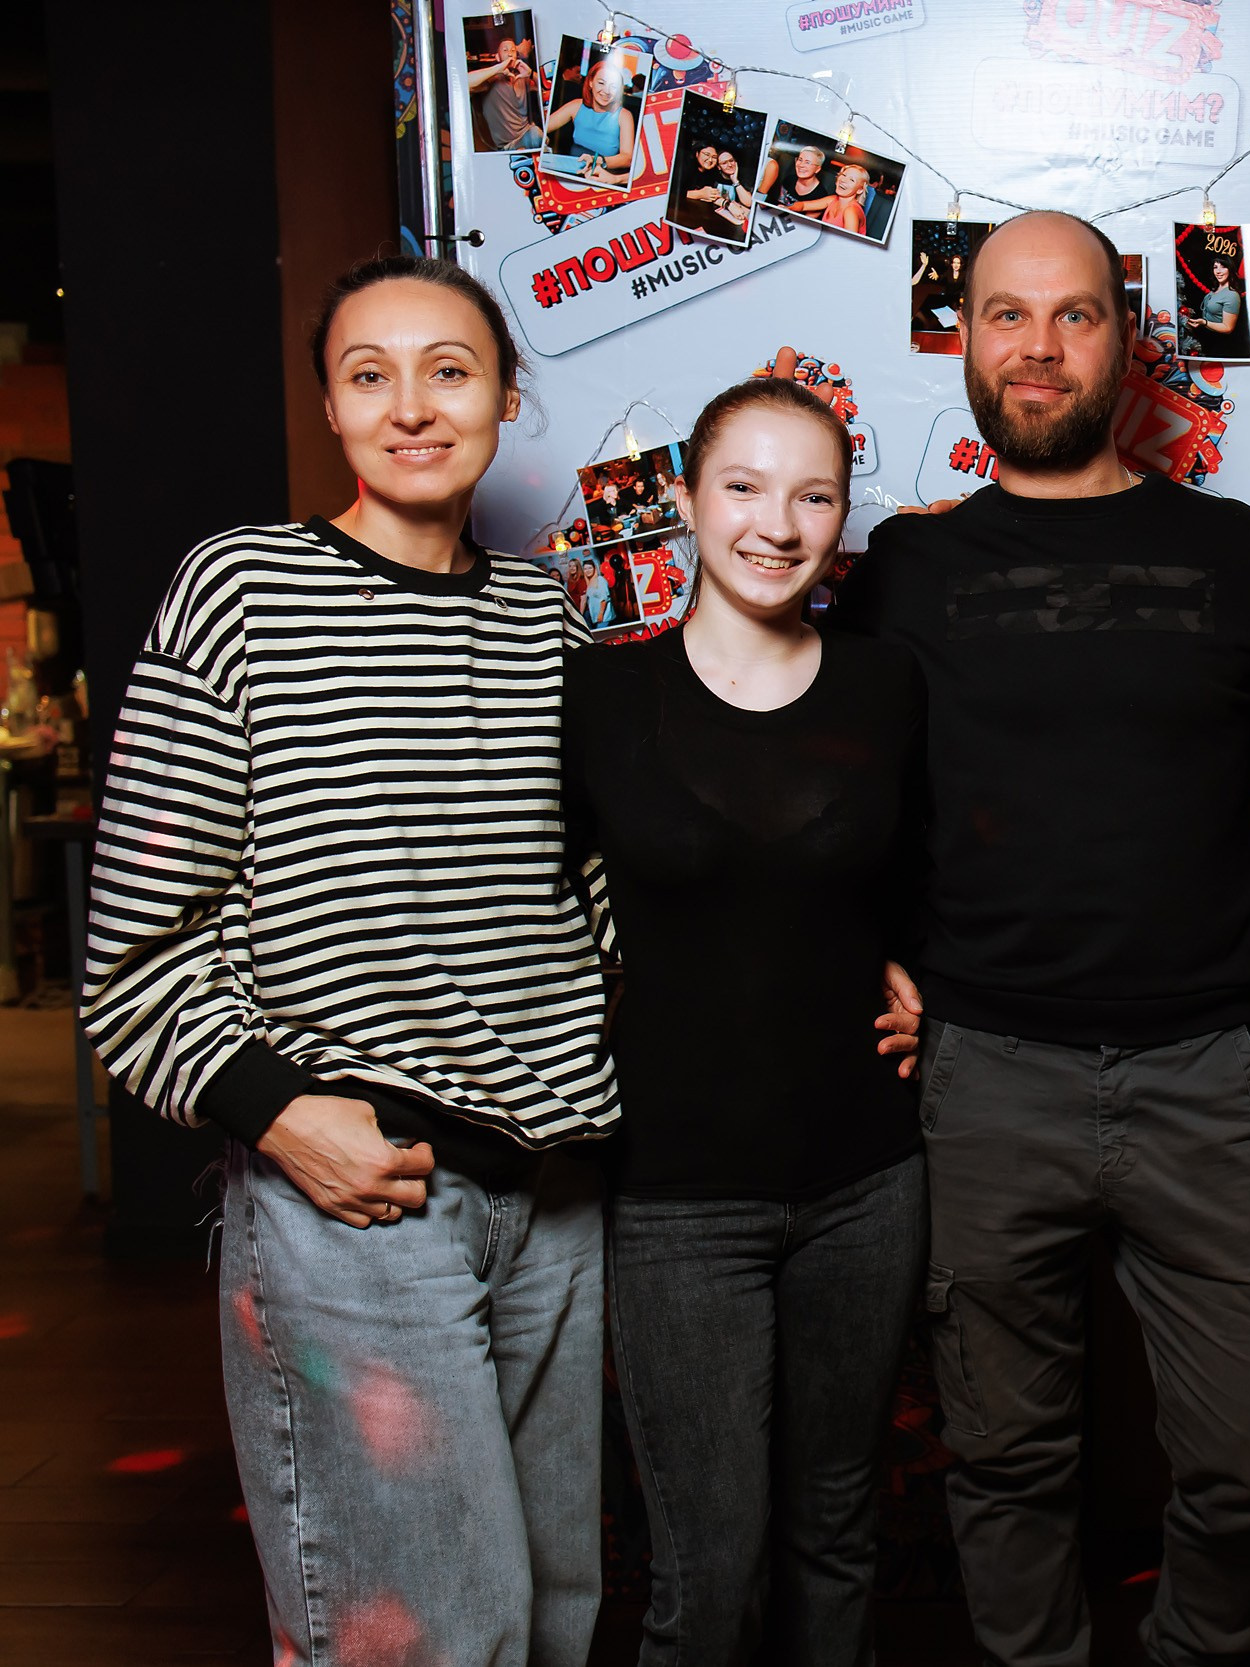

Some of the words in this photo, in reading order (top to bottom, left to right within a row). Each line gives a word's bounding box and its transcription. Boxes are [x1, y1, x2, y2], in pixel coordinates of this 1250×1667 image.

[840, 18, 881, 35] #MUSIC
[883, 10, 914, 24] GAME
[1069, 122, 1149, 144] #MUSIC
[1154, 128, 1215, 148] GAME
[1205, 233, 1238, 257] 2026
[531, 216, 693, 308] #ПОШУ
[631, 244, 723, 300] #MUSIC
